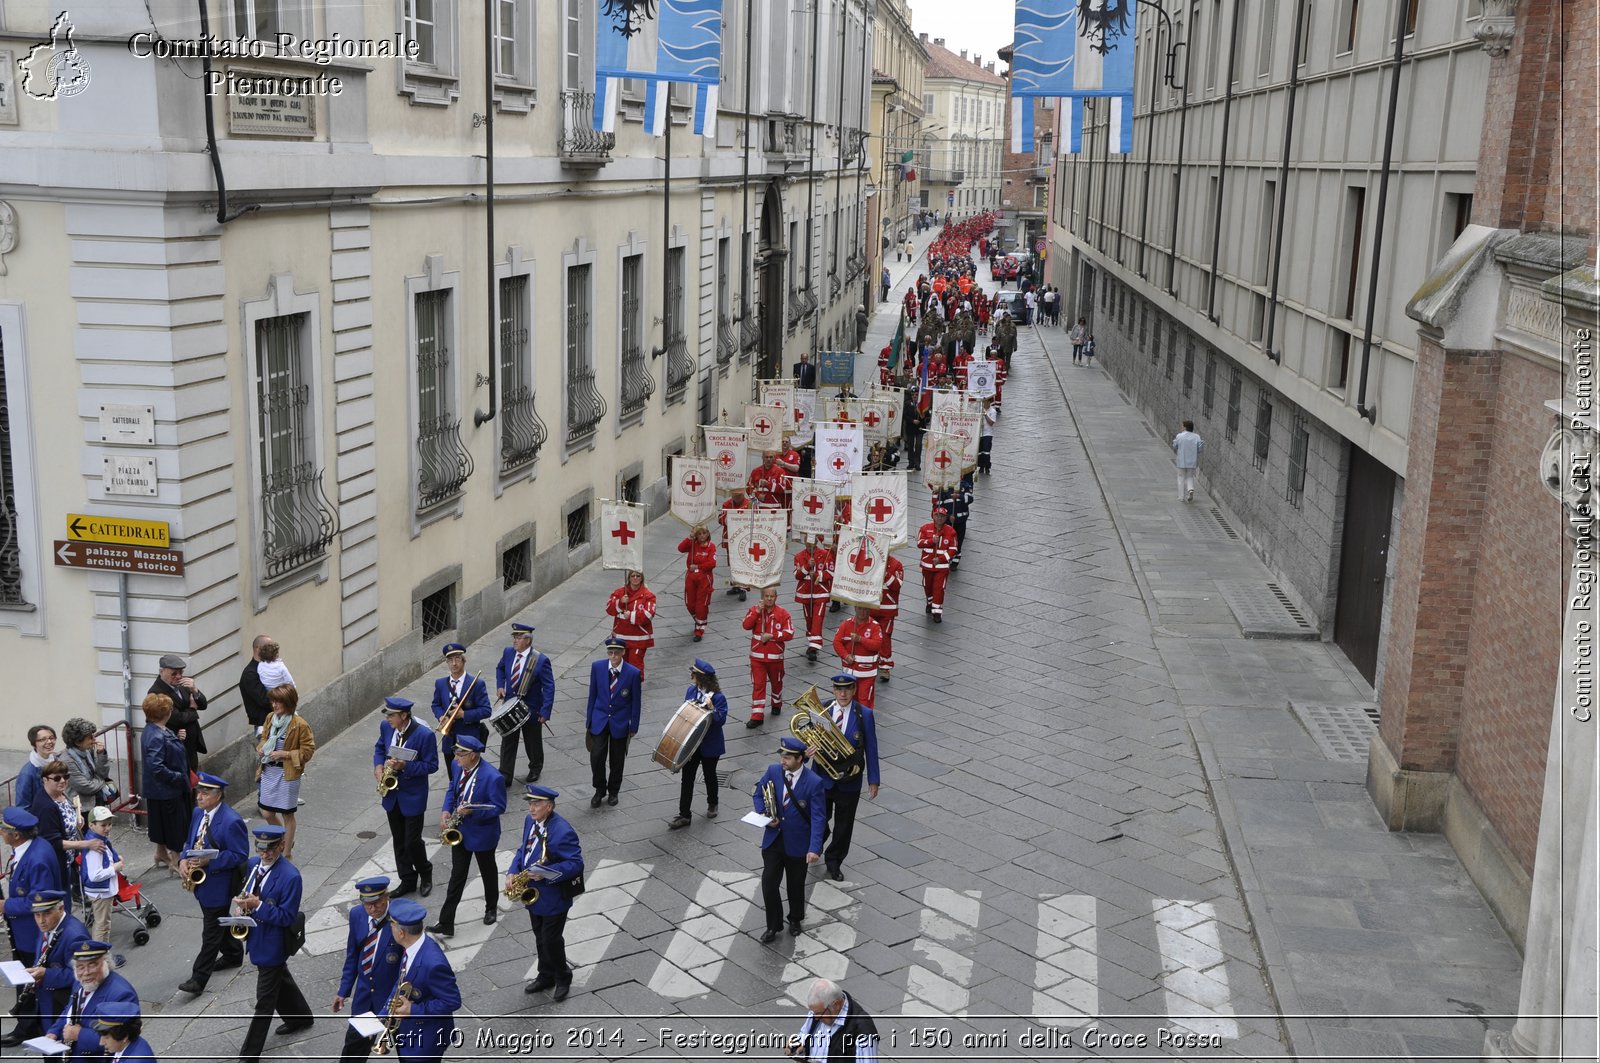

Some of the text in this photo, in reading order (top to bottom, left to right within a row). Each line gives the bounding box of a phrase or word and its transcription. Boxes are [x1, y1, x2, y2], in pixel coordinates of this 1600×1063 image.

[112, 416, 142, 425] CATTEDRALE
[117, 467, 141, 475] PIAZZA
[89, 522, 166, 541] CATTEDRALE
[85, 547, 179, 562] palazzo Mazzola
[86, 557, 177, 572] archivio storico
